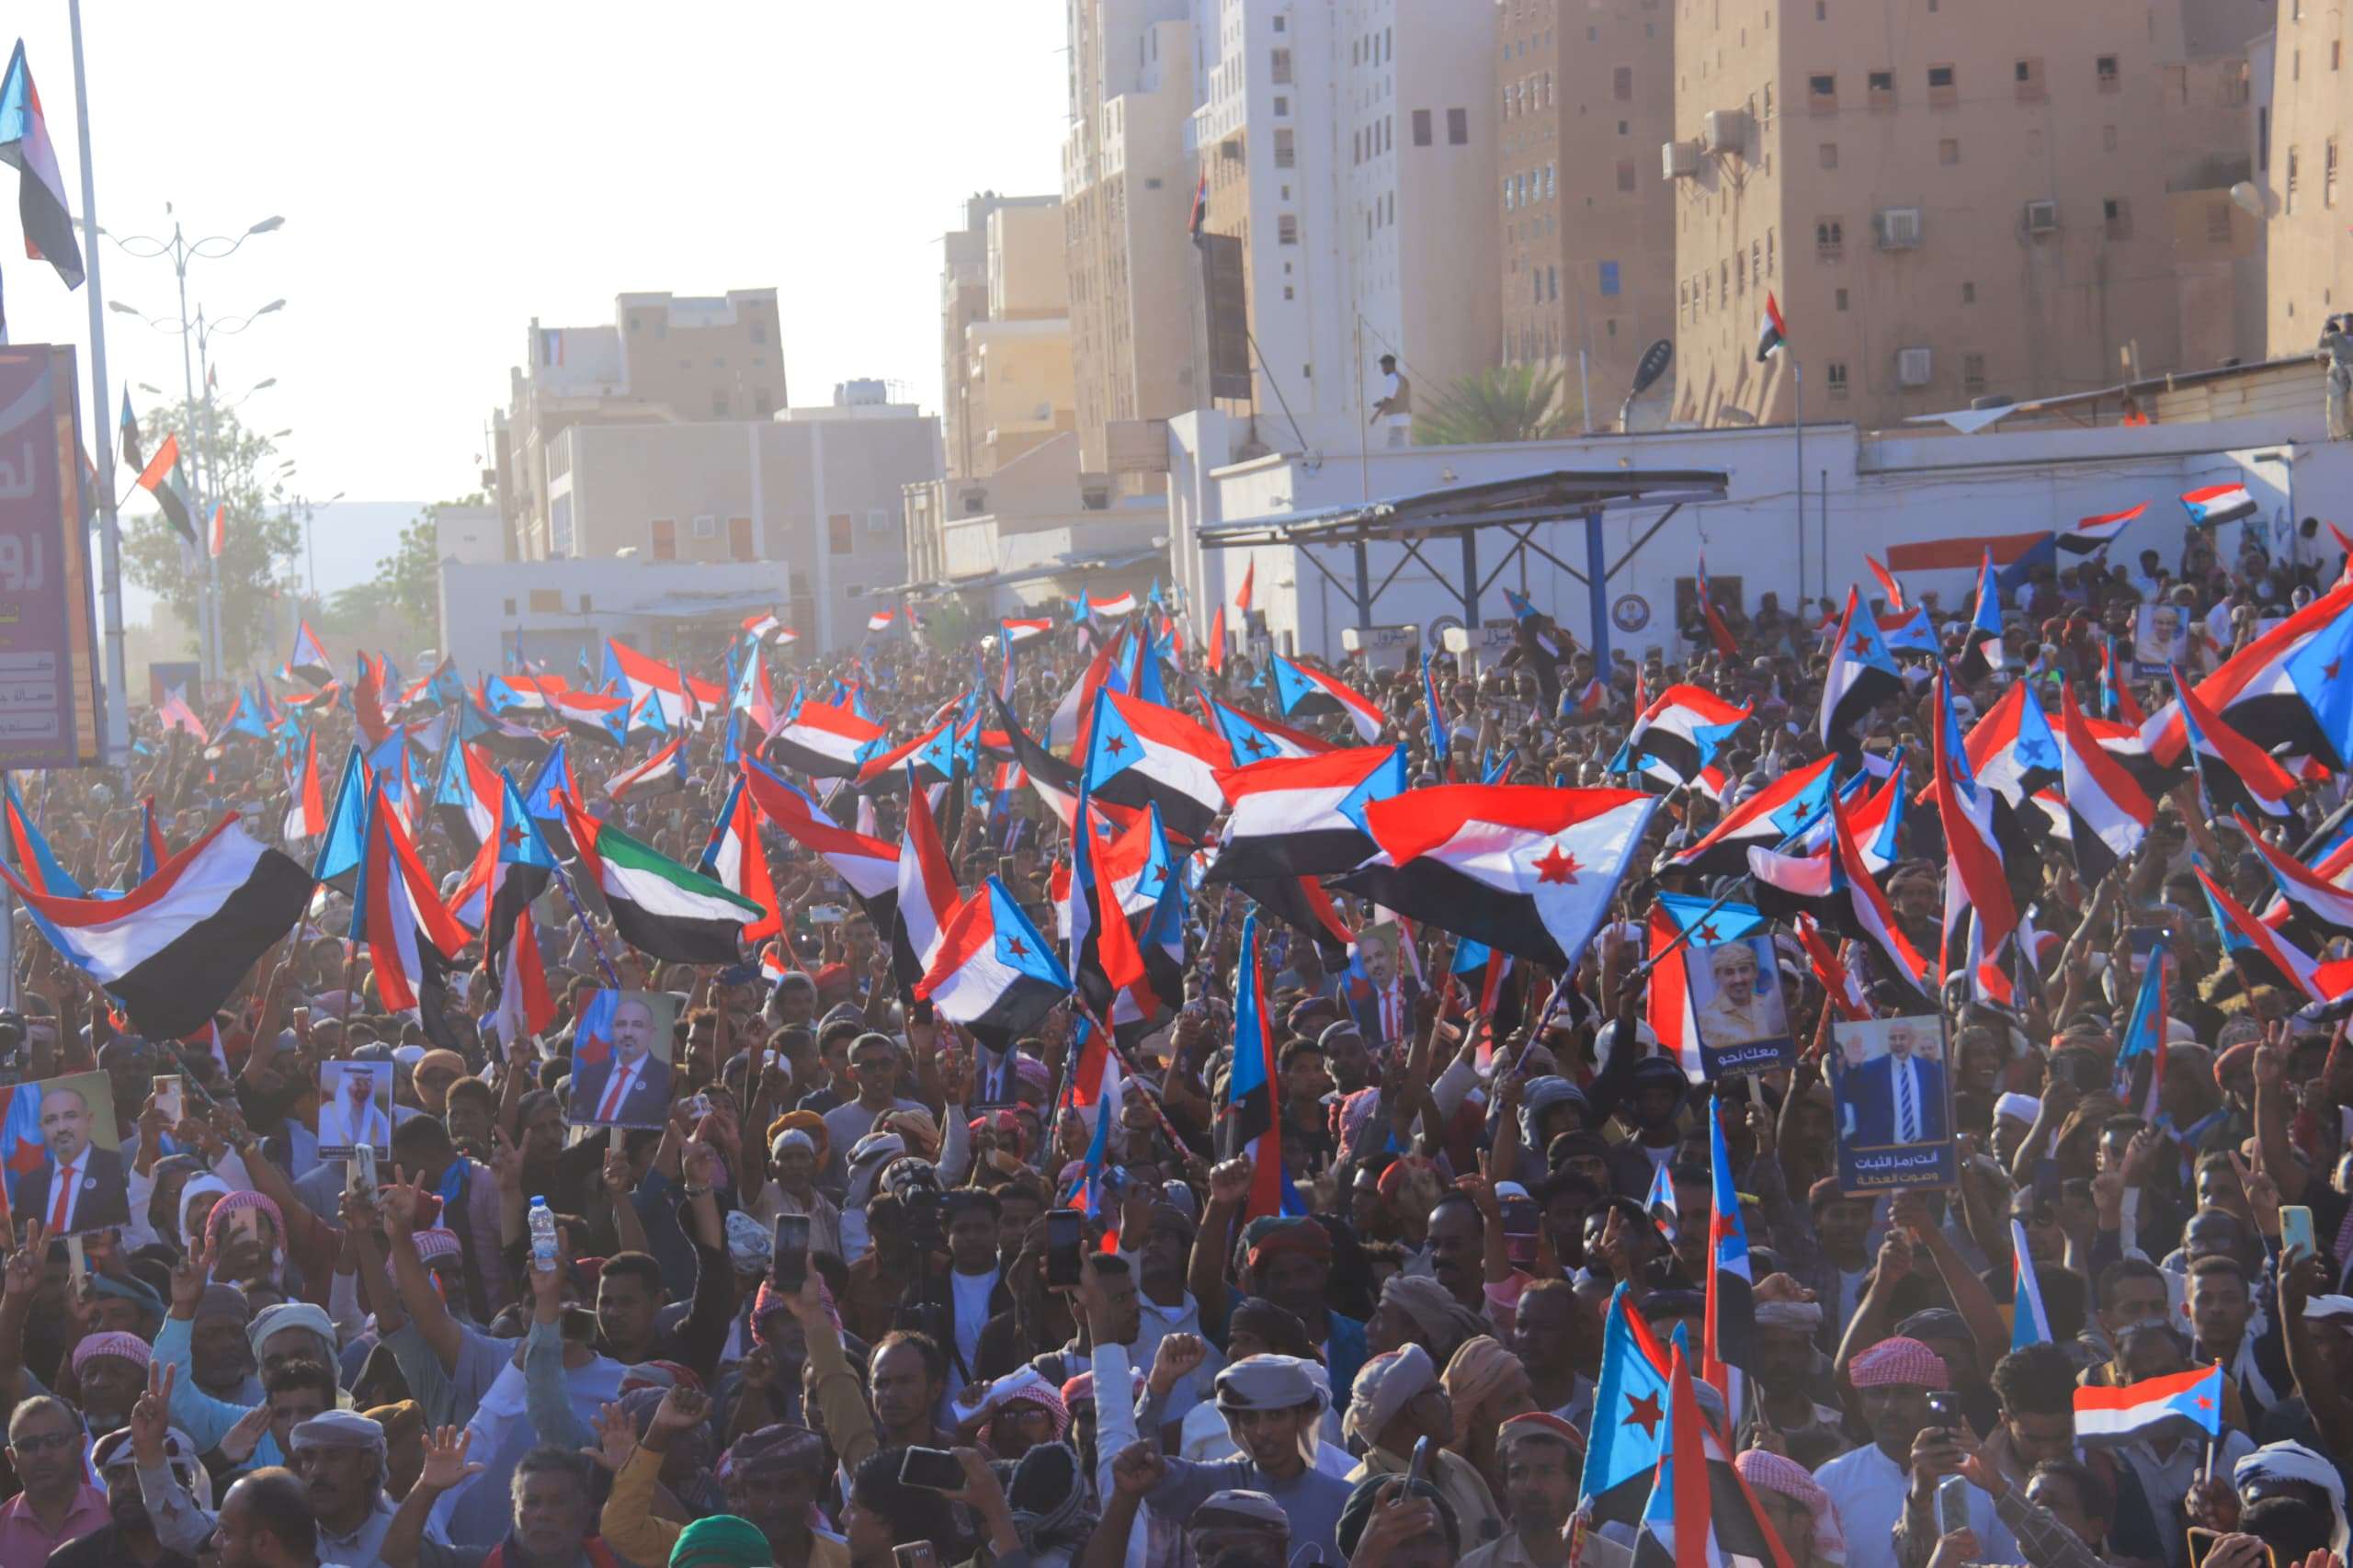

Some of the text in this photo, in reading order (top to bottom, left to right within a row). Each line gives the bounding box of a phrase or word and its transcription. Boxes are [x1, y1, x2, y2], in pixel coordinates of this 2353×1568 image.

[1855, 1149, 1938, 1170] أنت رمز الثبات
[1857, 1172, 1939, 1186] وصوت العدالة
